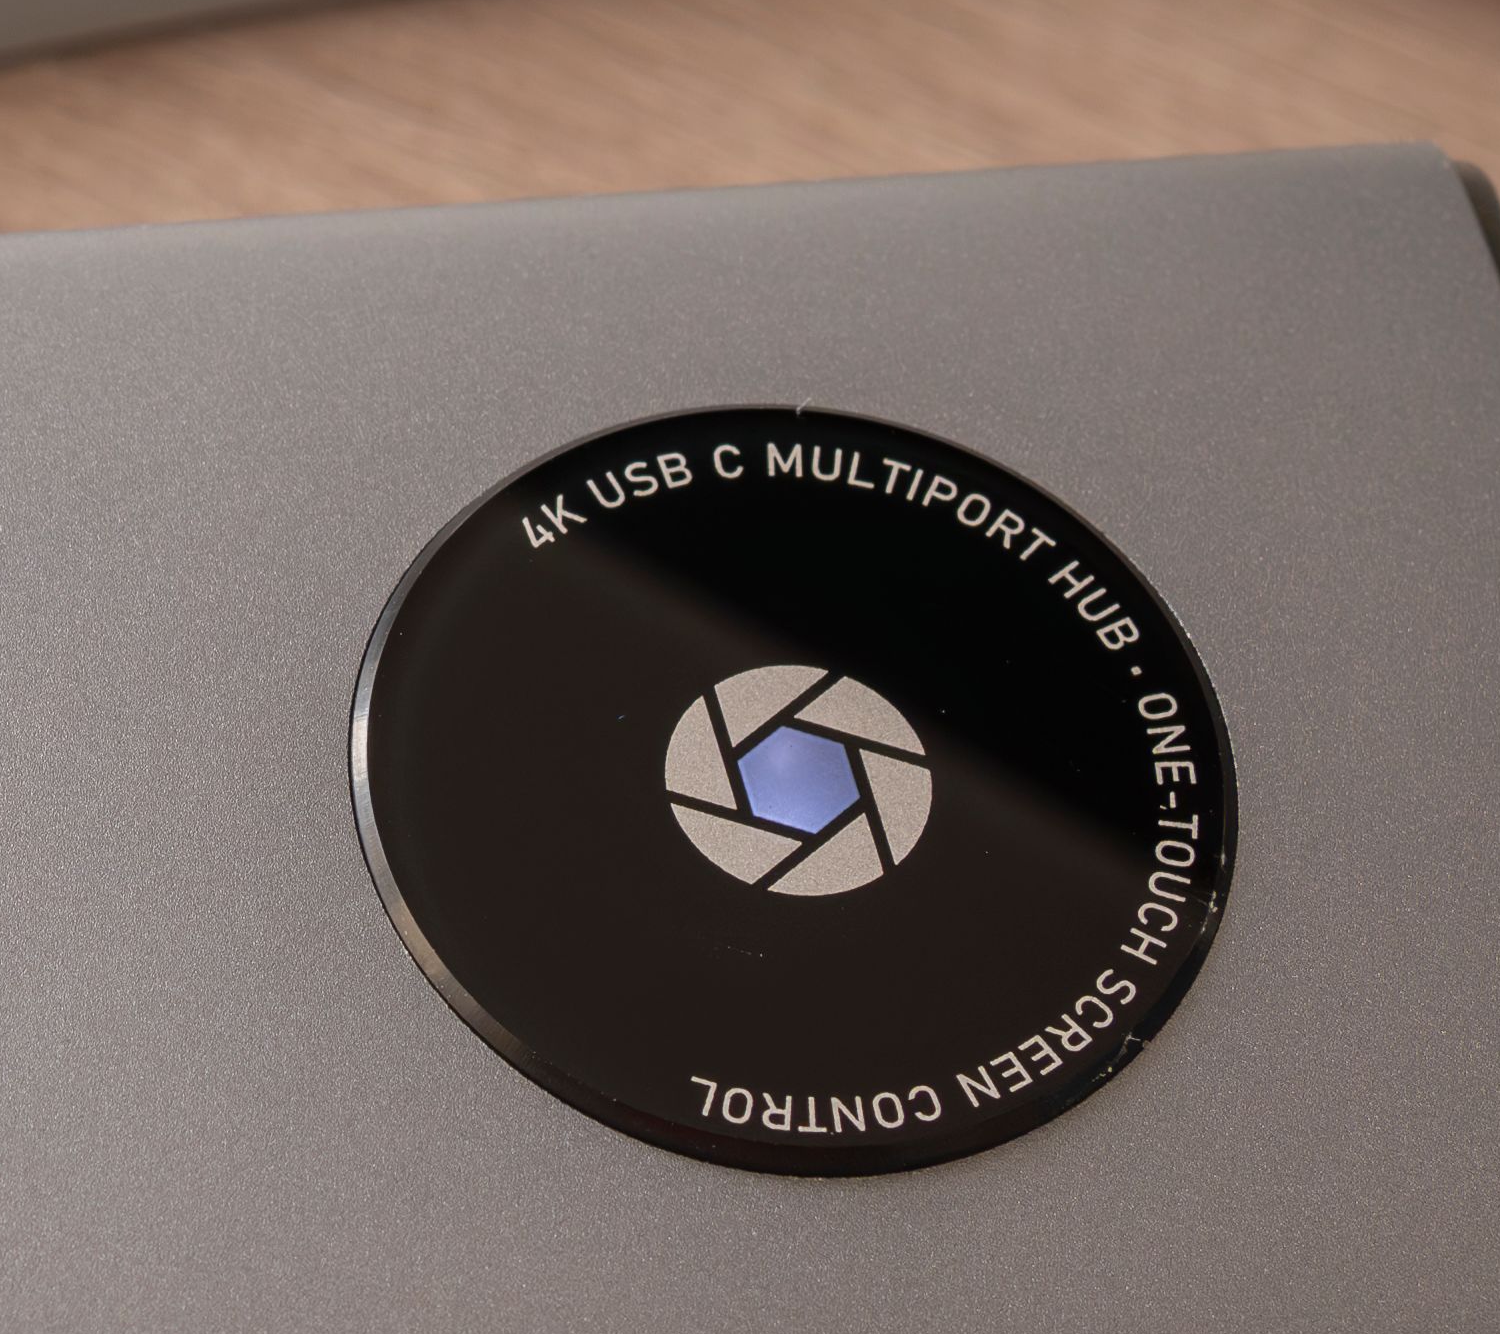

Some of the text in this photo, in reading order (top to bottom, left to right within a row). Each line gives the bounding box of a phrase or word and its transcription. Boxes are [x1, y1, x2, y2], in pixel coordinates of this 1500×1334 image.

[522, 443, 1198, 1132] 4K USB C MULTIPORT HUB ONE-TOUCH SCREEN CONTROL
